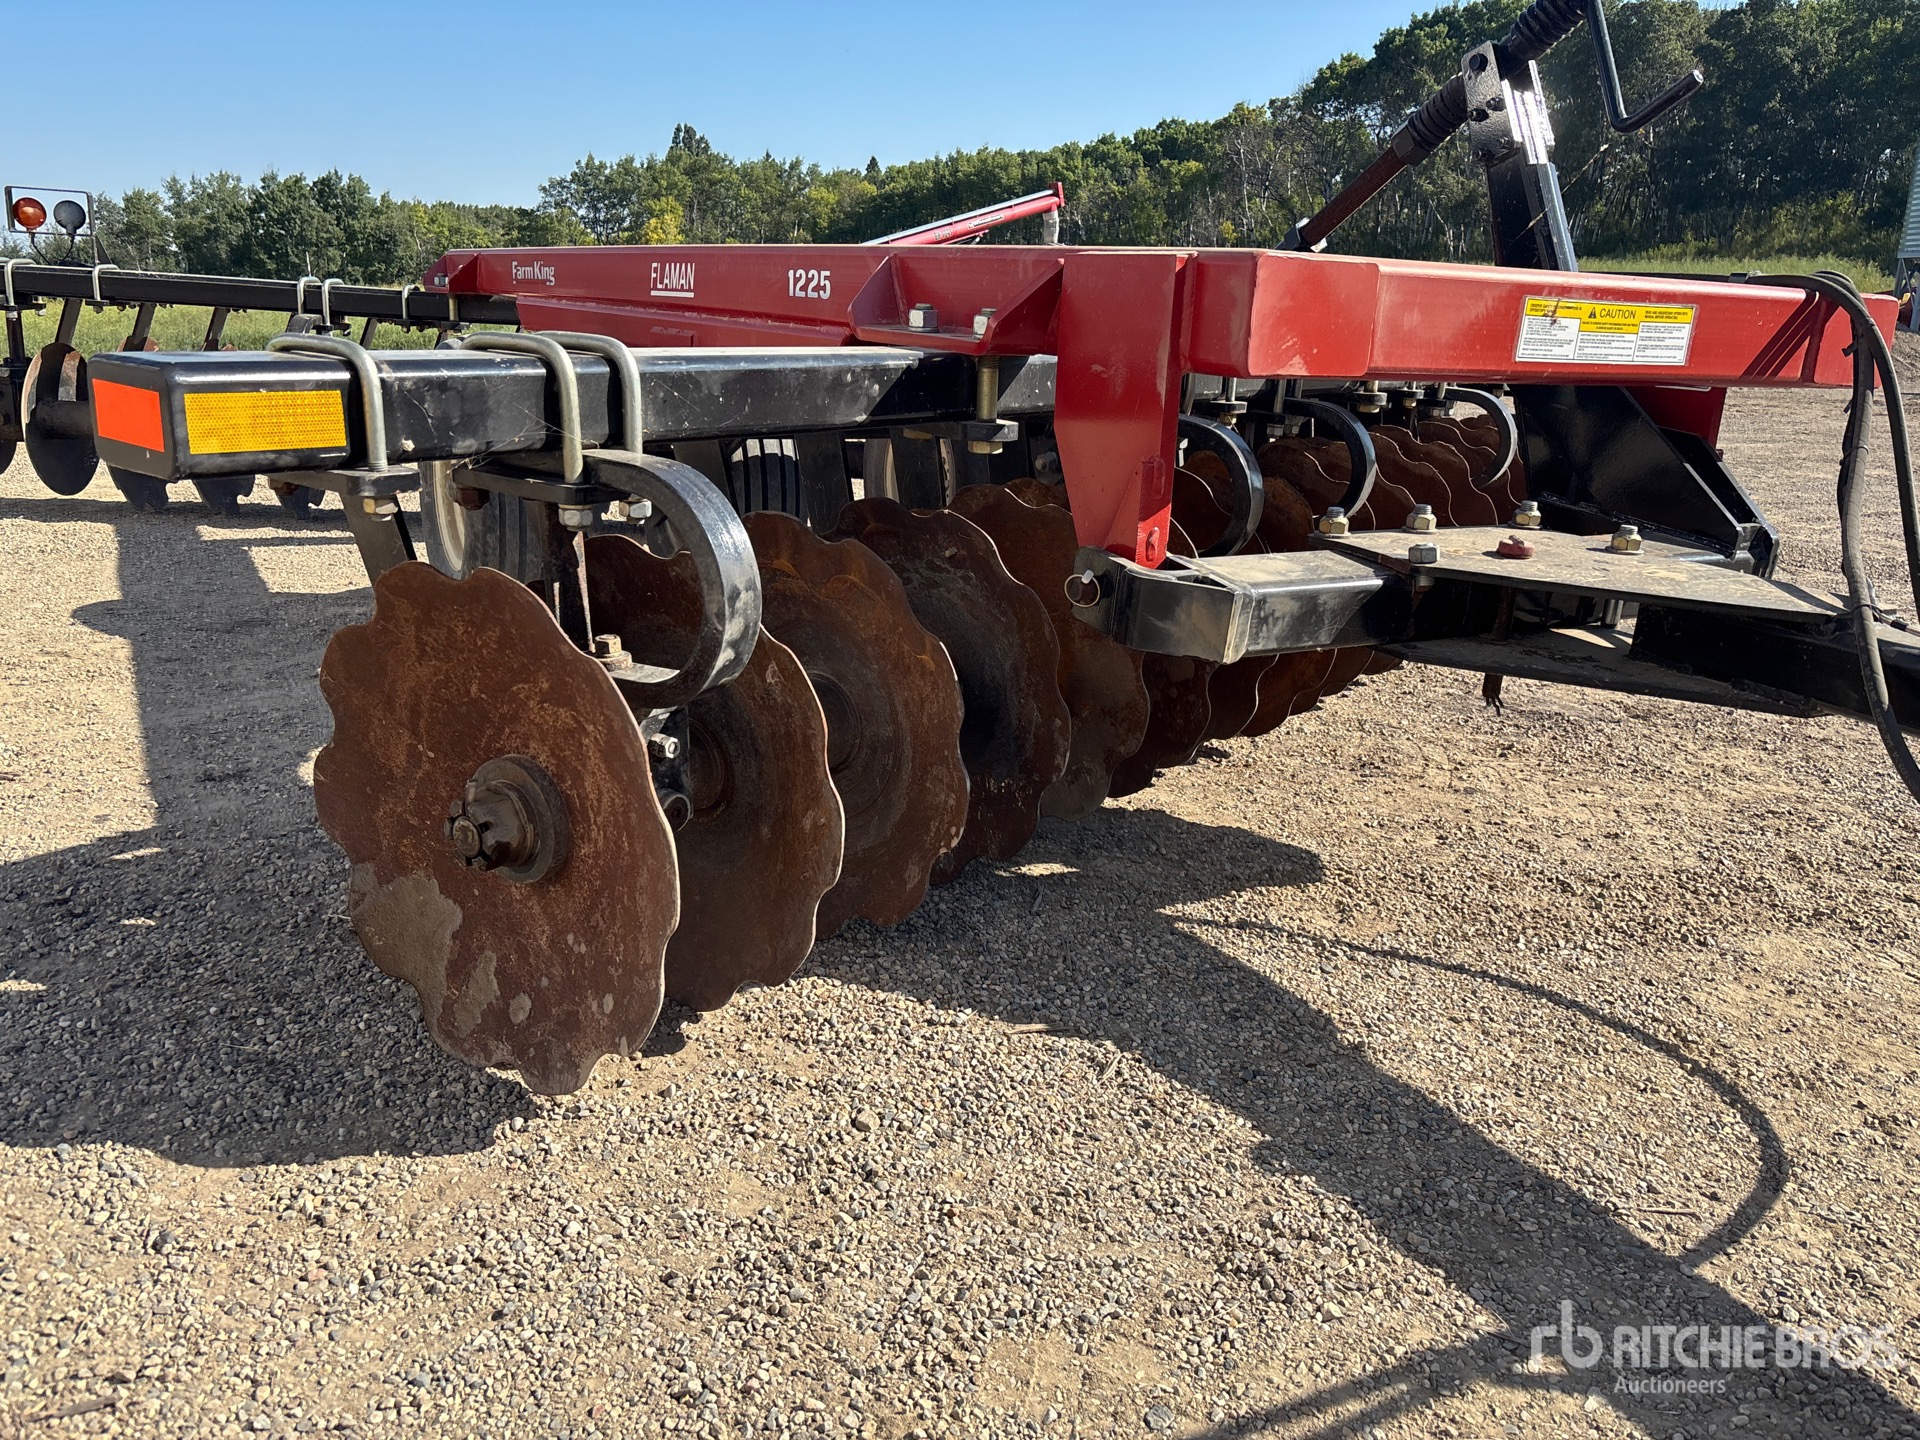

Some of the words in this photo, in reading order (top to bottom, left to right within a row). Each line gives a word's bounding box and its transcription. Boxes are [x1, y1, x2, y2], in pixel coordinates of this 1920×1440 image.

[512, 260, 534, 280] Farm
[533, 260, 556, 286] King
[650, 262, 695, 290] FLAMAN
[786, 269, 831, 300] 1225
[1599, 308, 1637, 320] CAUTION
